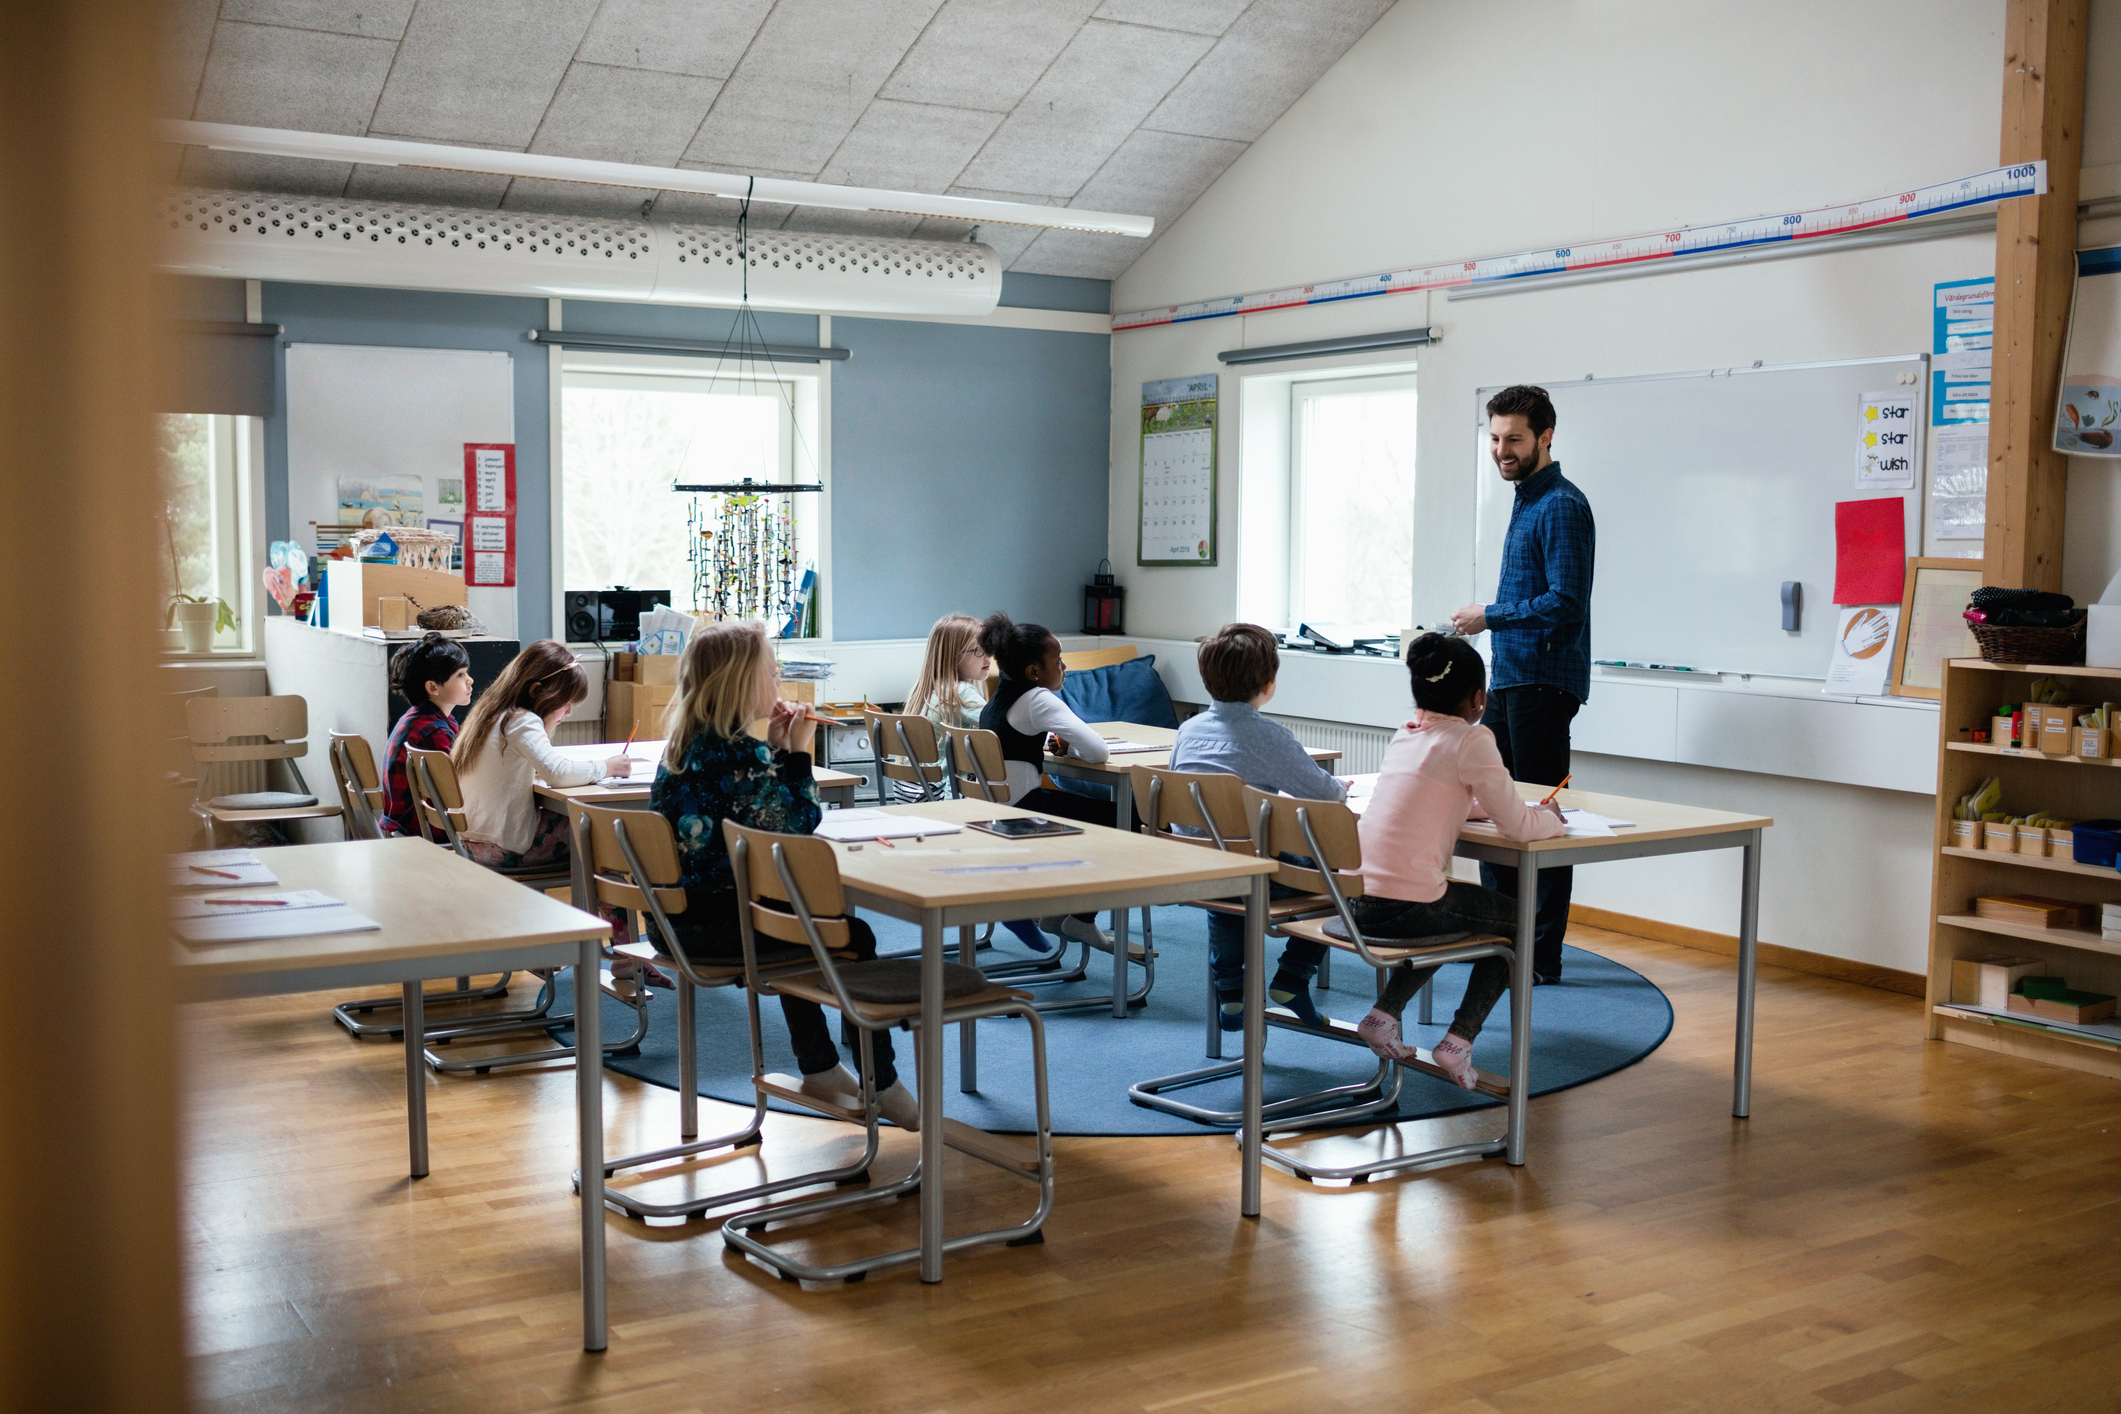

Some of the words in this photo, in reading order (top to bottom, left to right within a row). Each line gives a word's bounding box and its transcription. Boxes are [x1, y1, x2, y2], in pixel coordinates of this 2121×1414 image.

[1380, 274, 1392, 282] 400
[1464, 262, 1476, 271] 500
[1556, 249, 1571, 258] 600
[1665, 233, 1681, 242] 700
[1783, 215, 1801, 225] 800
[1900, 193, 1915, 204] 900
[1960, 182, 1971, 190] 950
[2006, 166, 2036, 180] 1000
[1882, 406, 1909, 419] star
[1881, 432, 1908, 444] star
[1880, 456, 1908, 471] wish
